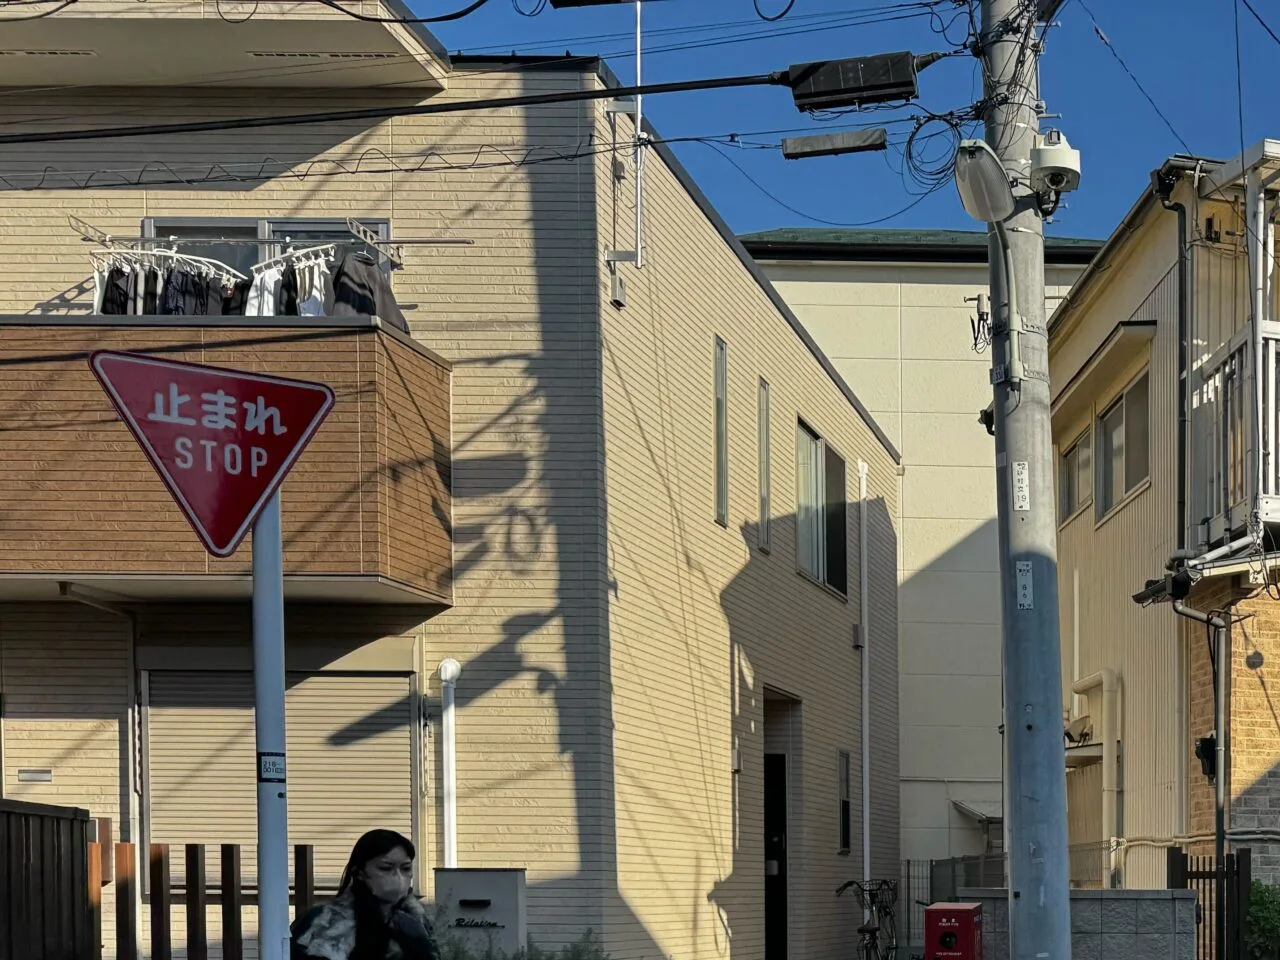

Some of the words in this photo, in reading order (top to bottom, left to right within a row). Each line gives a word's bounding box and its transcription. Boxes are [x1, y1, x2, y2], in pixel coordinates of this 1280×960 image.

[147, 382, 288, 436] 止まれ
[174, 437, 268, 478] STOP
